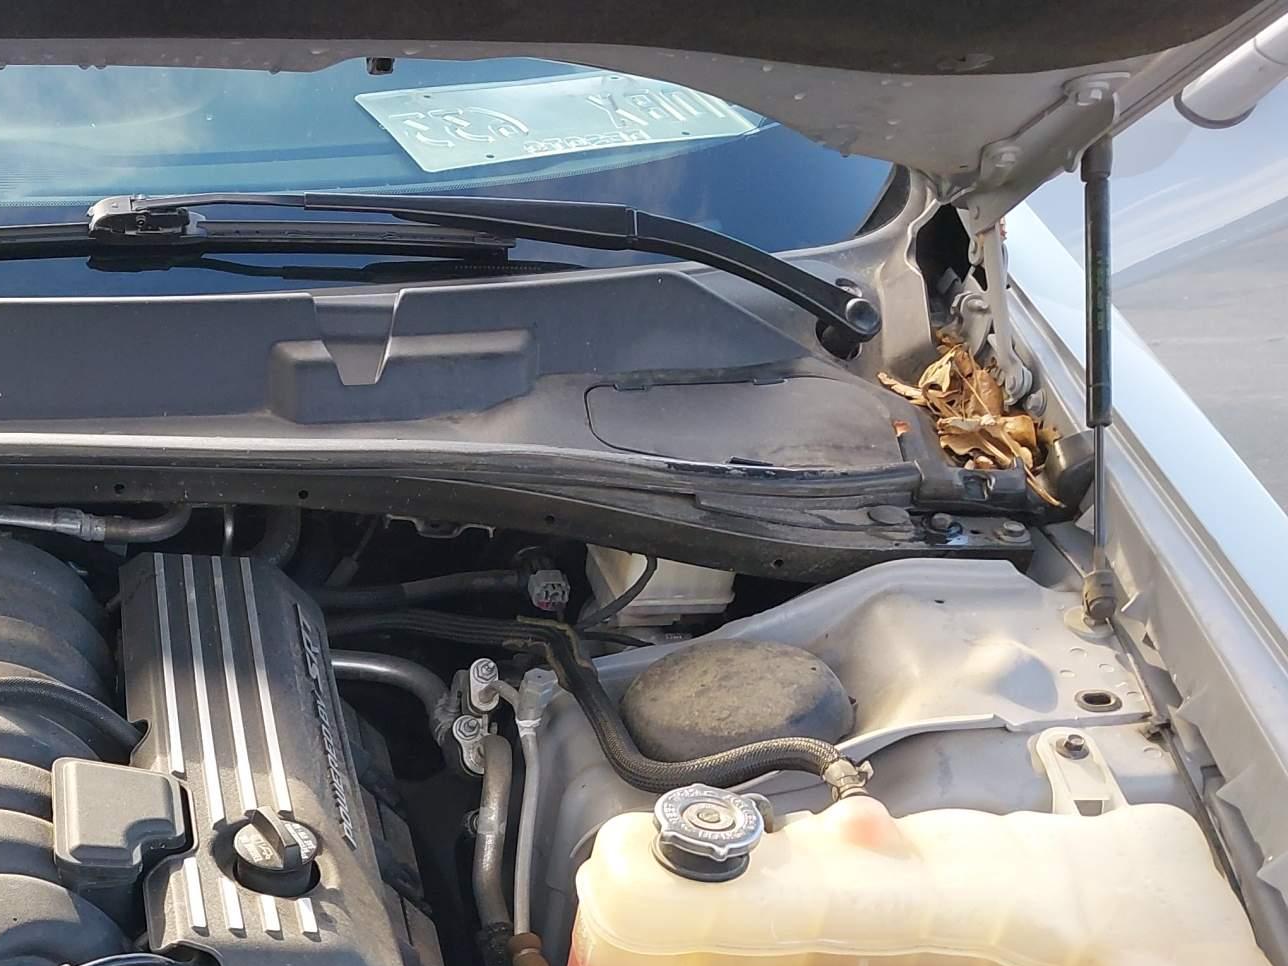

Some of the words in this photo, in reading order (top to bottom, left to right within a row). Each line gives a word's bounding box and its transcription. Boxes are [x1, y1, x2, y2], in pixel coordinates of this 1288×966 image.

[296, 604, 323, 691] SRT
[312, 690, 329, 728] BY
[322, 725, 357, 848] POWERED
